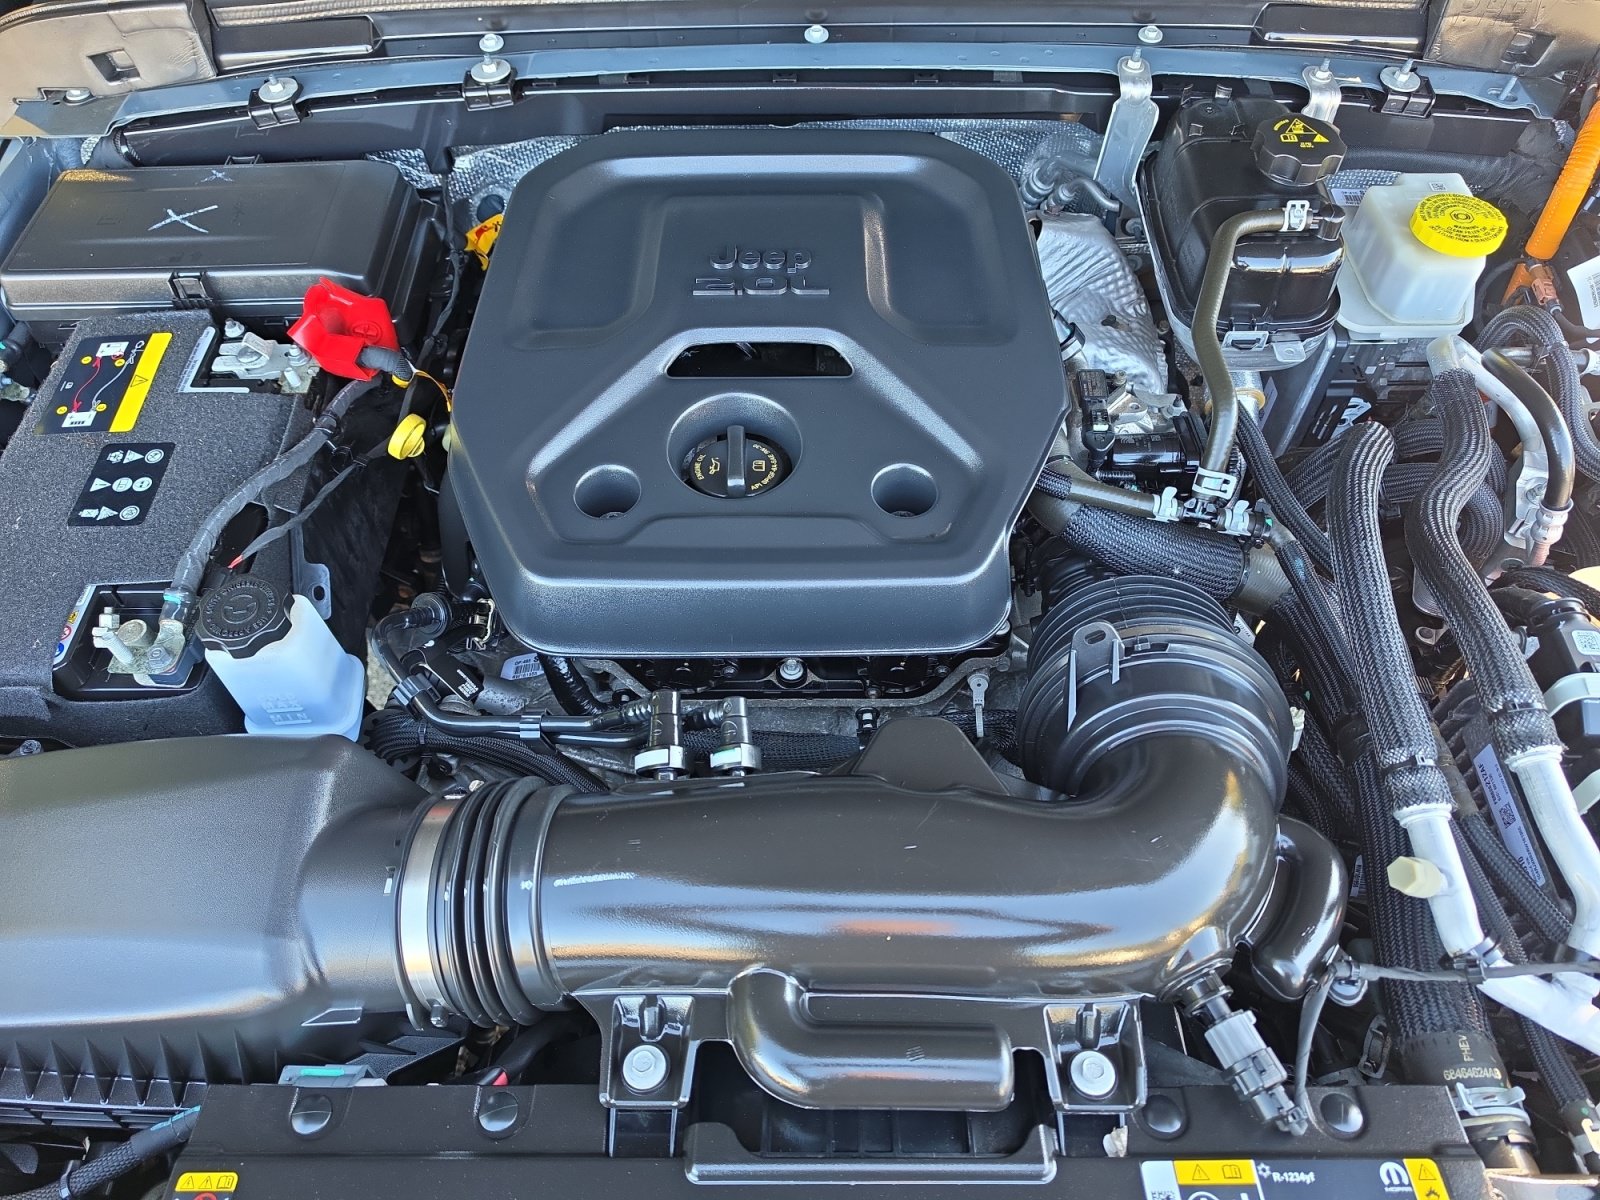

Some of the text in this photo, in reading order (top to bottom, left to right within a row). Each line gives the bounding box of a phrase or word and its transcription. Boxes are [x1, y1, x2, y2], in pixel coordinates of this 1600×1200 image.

[709, 243, 812, 274] Jeep
[692, 277, 830, 296] 2.0L
[694, 454, 707, 480] ENGINE OIL
[269, 712, 311, 724] MIN
[1459, 1035, 1474, 1062] PHEV
[1272, 1171, 1315, 1184] R-1234yf
